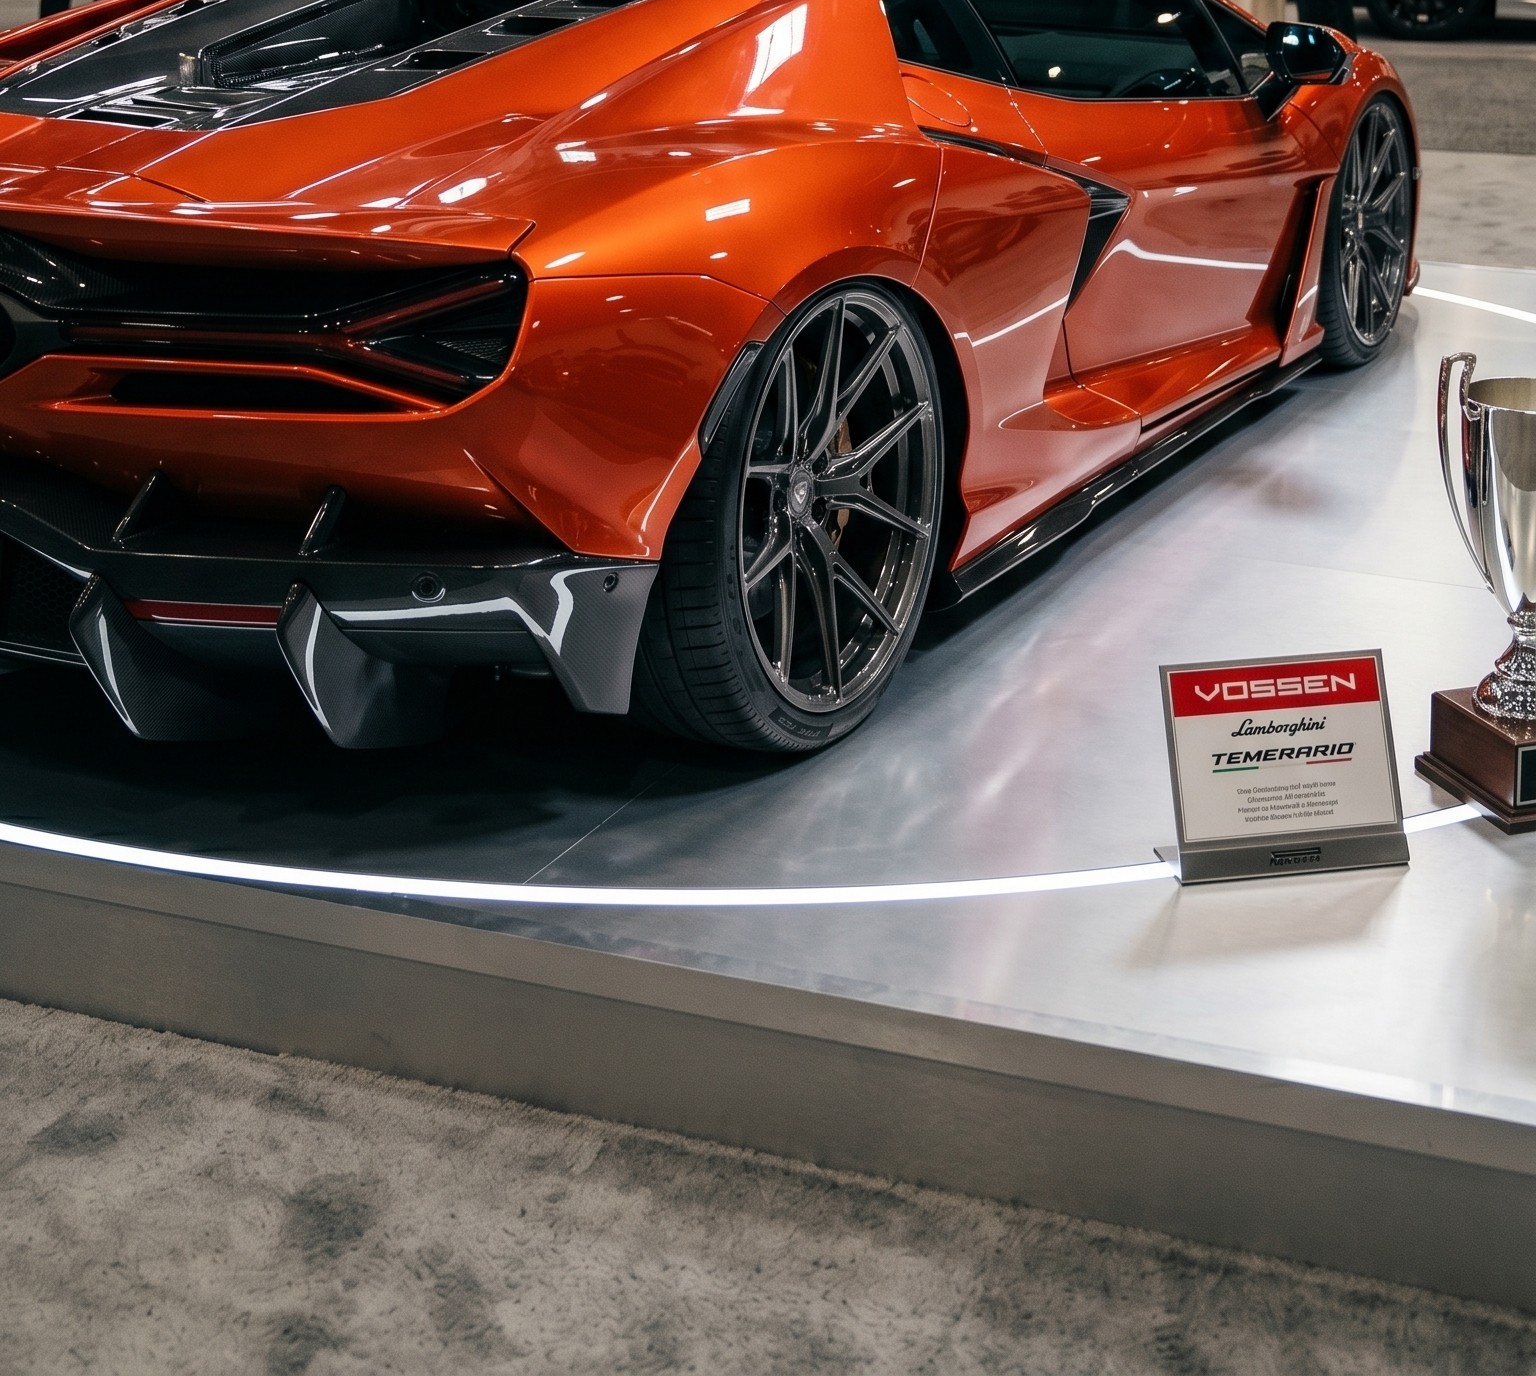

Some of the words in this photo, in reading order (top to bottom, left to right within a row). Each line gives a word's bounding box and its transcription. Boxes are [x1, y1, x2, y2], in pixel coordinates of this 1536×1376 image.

[1194, 672, 1357, 702] VOSSEN
[1231, 716, 1327, 738] Lamborghini
[1211, 742, 1355, 766] TEMERARIO
